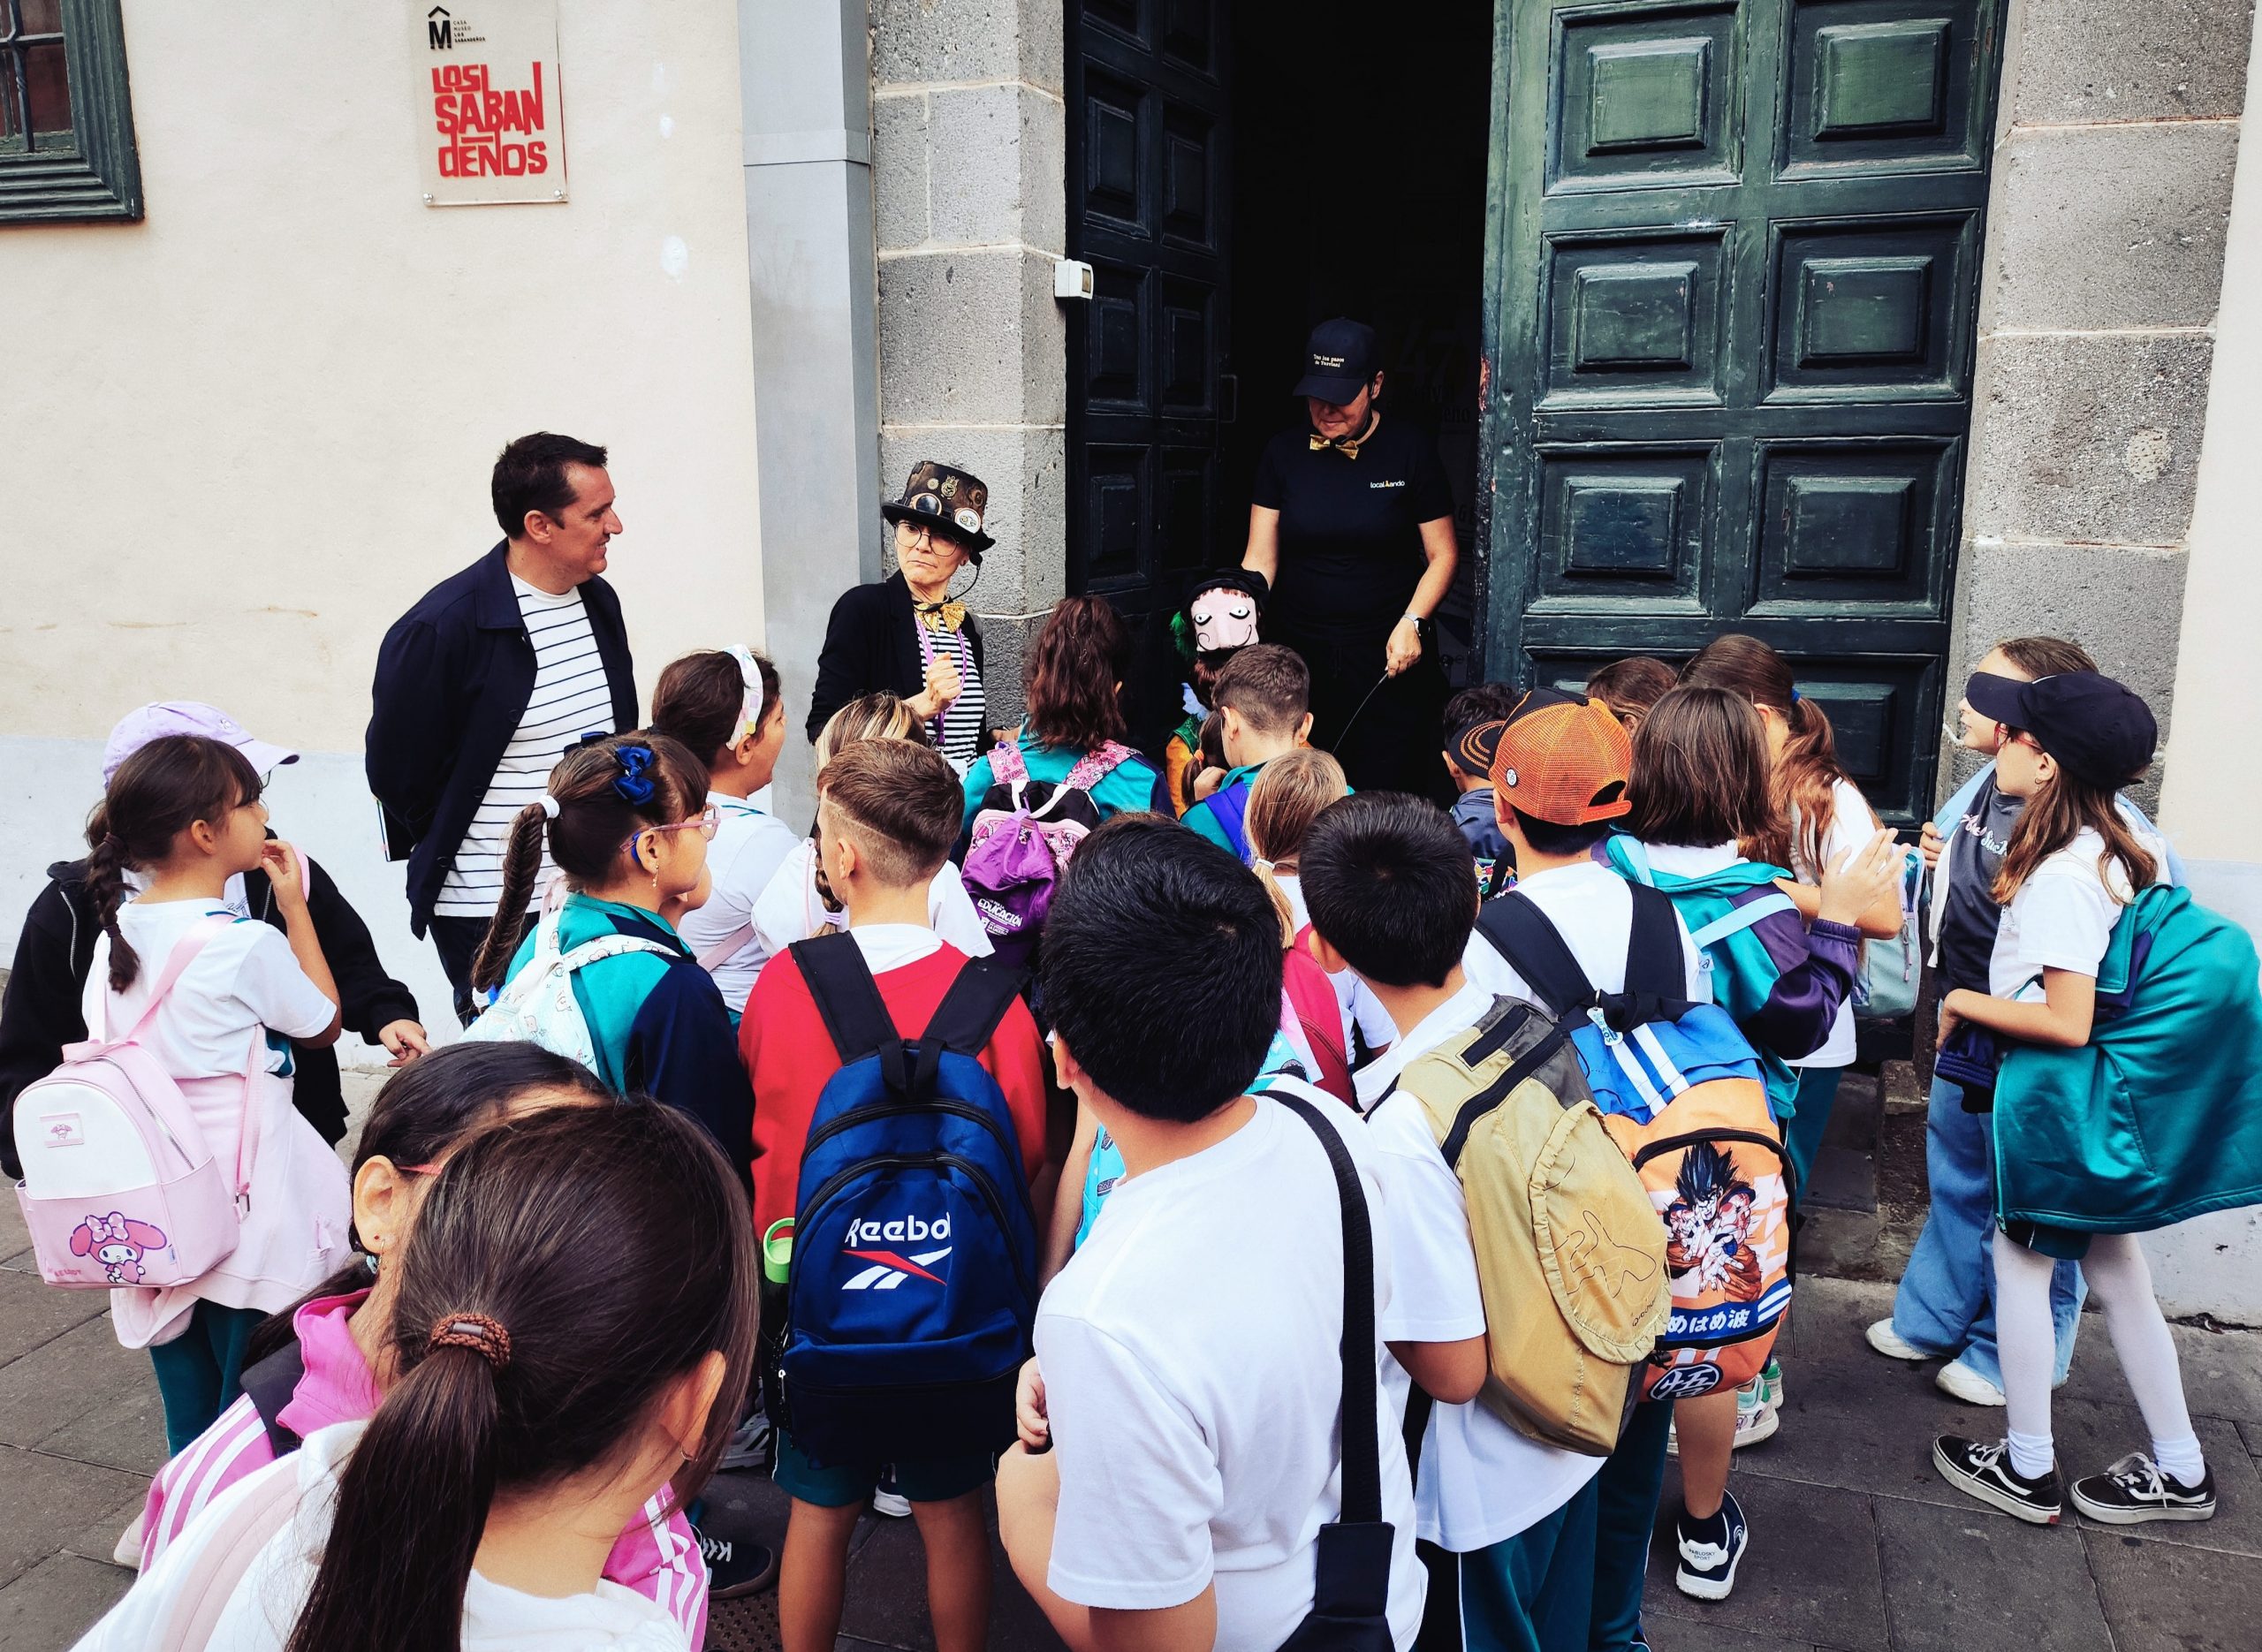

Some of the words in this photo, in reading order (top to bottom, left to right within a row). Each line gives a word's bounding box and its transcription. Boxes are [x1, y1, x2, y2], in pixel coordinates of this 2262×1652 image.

[431, 64, 482, 93] LOS
[435, 62, 545, 135] SABAN
[977, 898, 1023, 928] EDUCACIÓN
